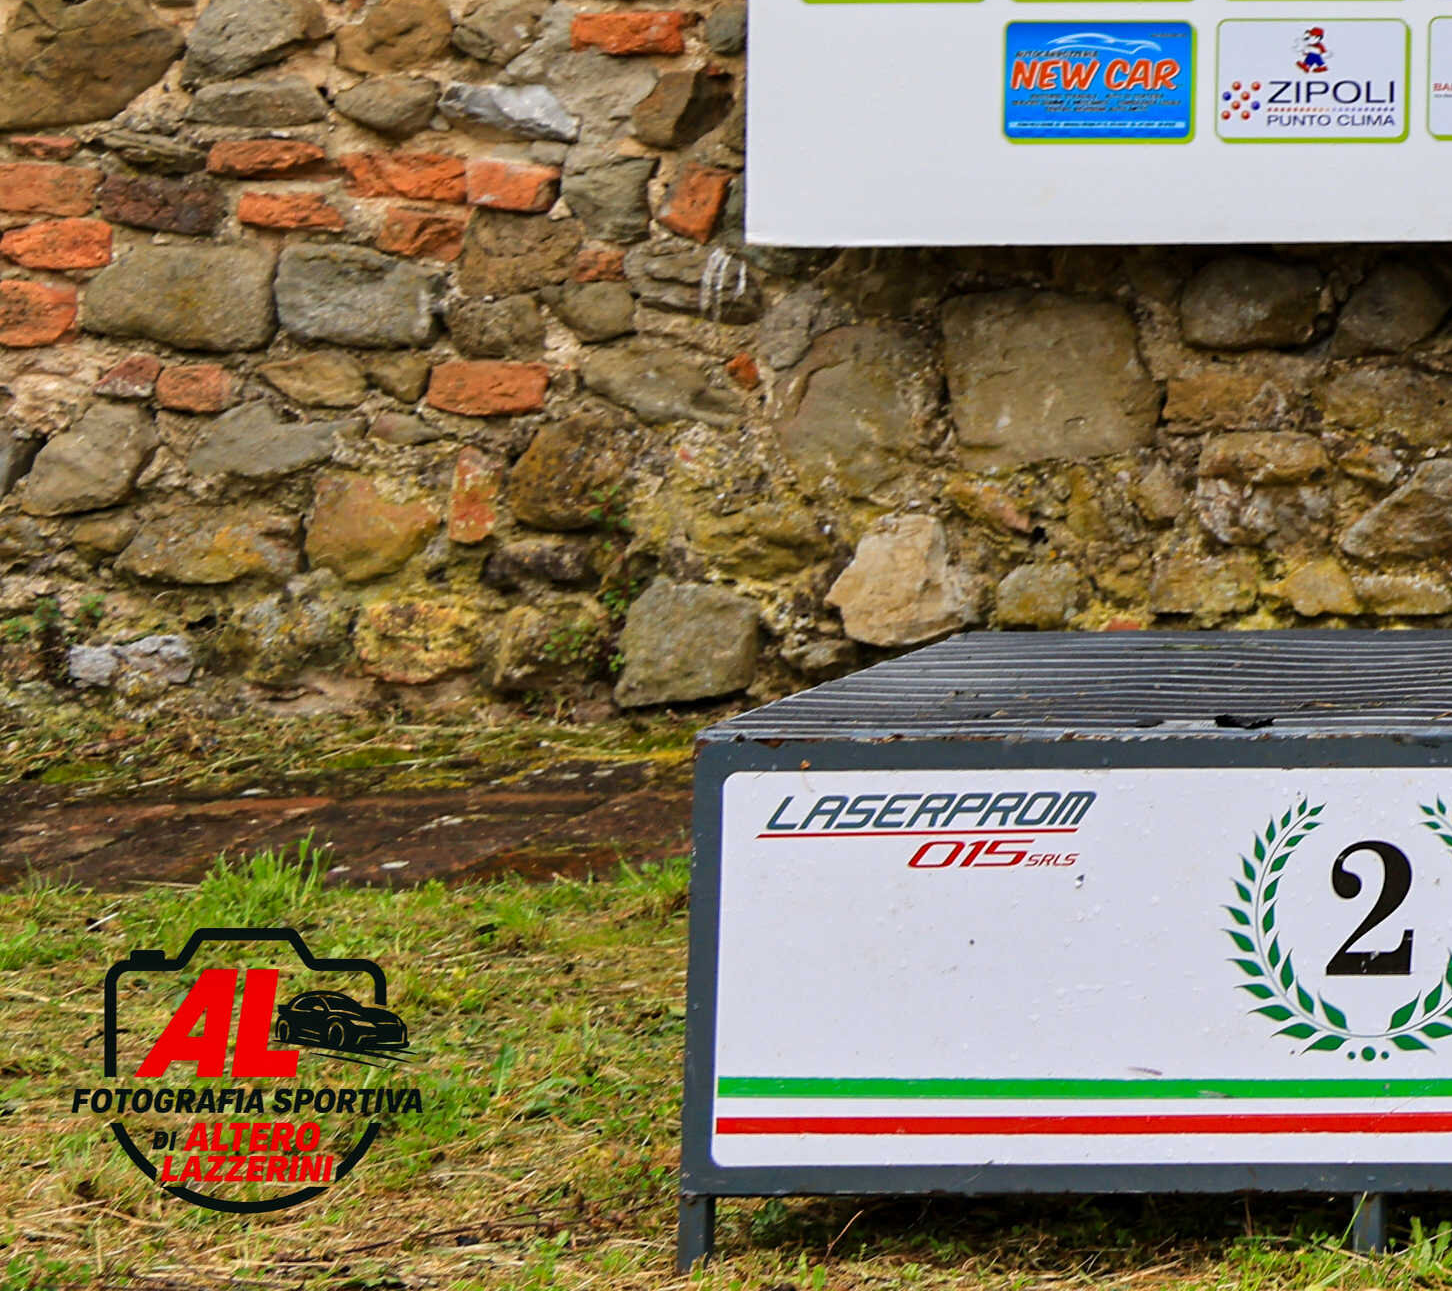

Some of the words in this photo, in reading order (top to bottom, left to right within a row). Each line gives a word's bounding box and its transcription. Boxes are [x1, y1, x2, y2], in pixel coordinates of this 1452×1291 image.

[1010, 59, 1100, 90] NEW
[1104, 59, 1180, 90] CAR
[1268, 81, 1396, 105] ZIPOLI
[1267, 114, 1331, 127] PUNTO
[1337, 114, 1396, 127] CLIMA
[765, 791, 1097, 831] LASERPROM
[1025, 853, 1081, 868] SRLS
[1325, 840, 1414, 977] 2
